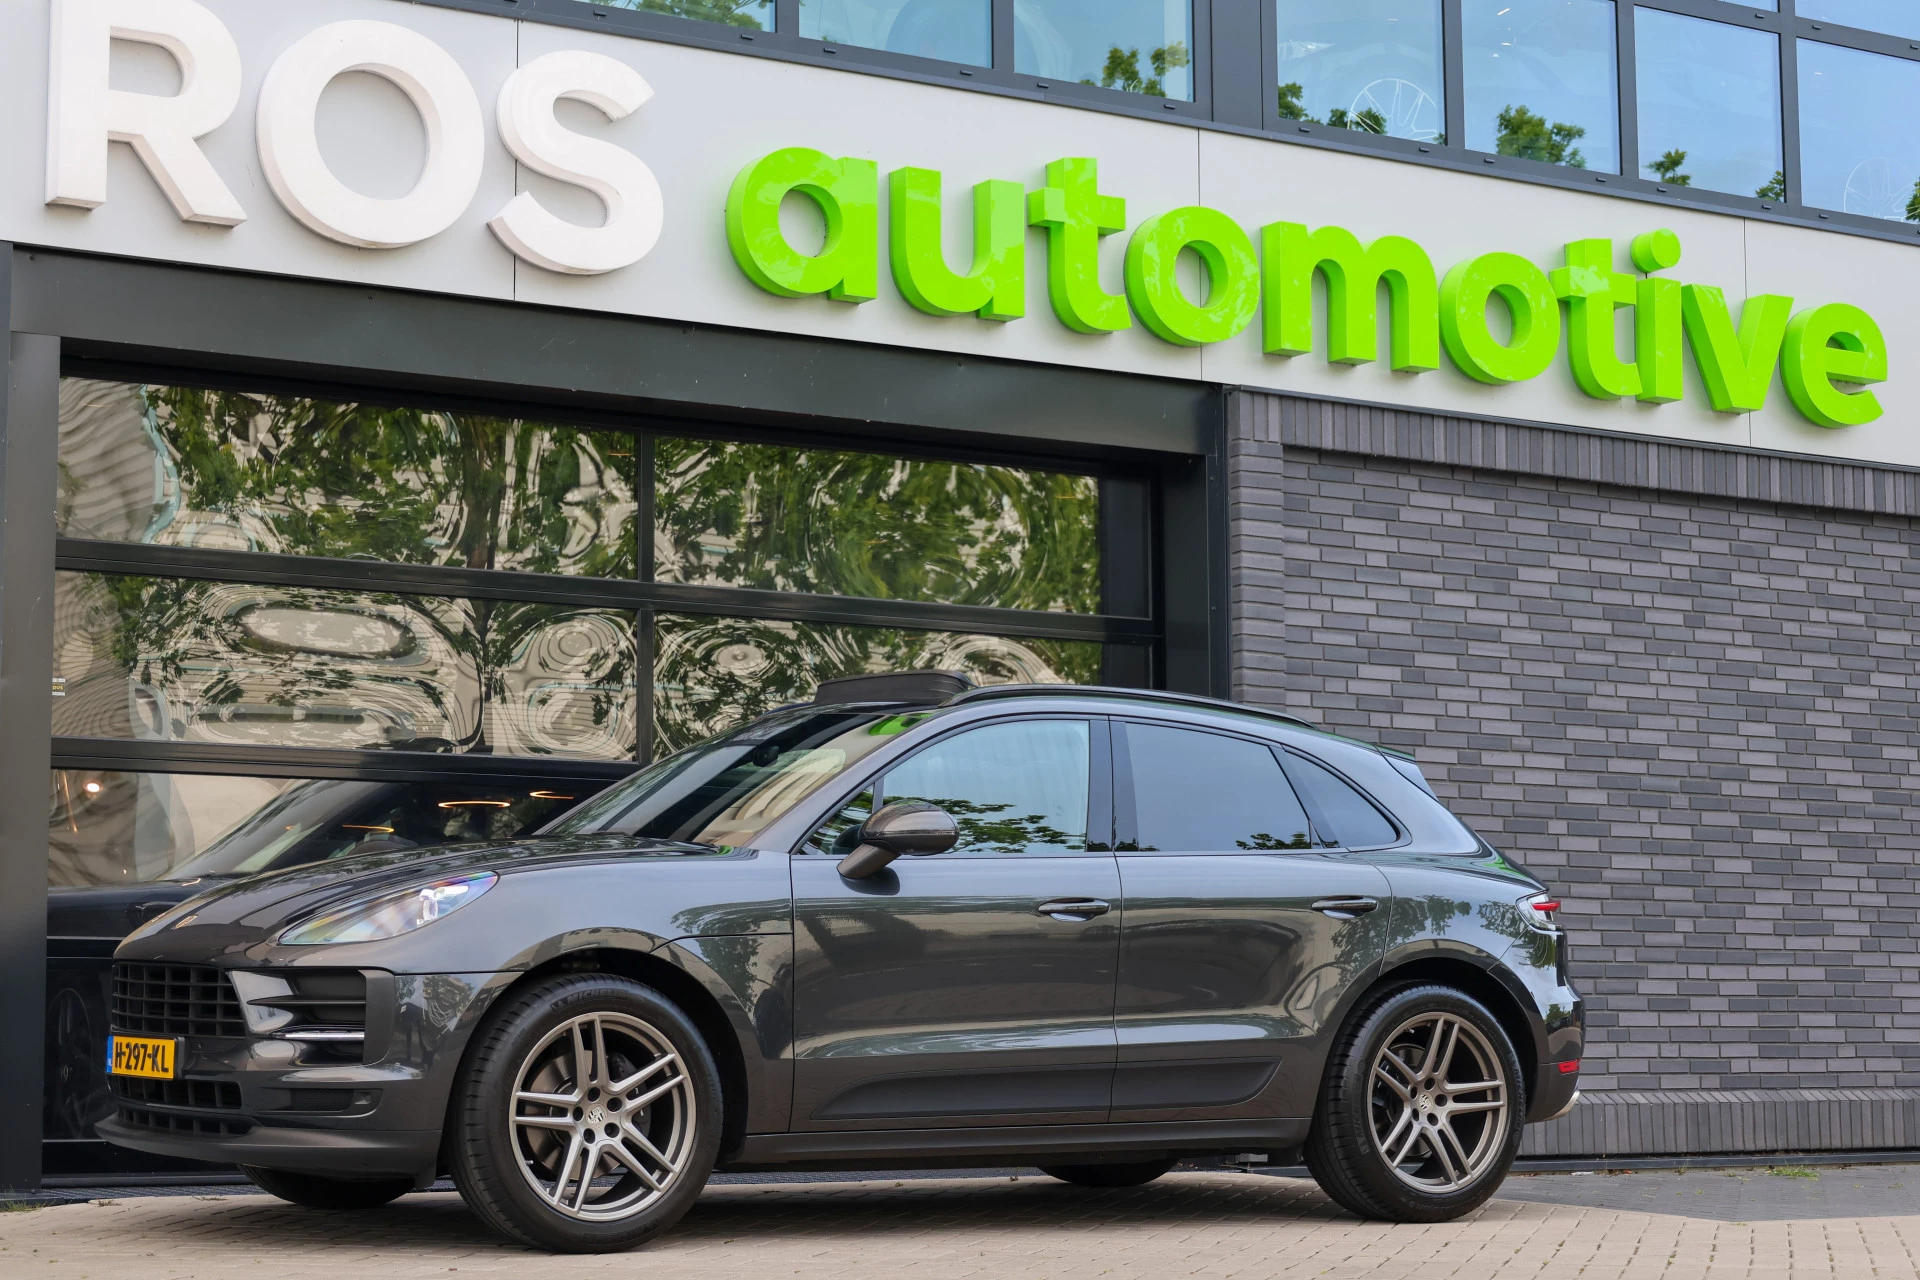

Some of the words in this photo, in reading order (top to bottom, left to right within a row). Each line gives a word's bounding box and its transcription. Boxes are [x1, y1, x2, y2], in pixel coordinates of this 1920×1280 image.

[45, 0, 664, 276] ROS
[725, 147, 1888, 428] automotive
[114, 1042, 169, 1073] H-297-KL
